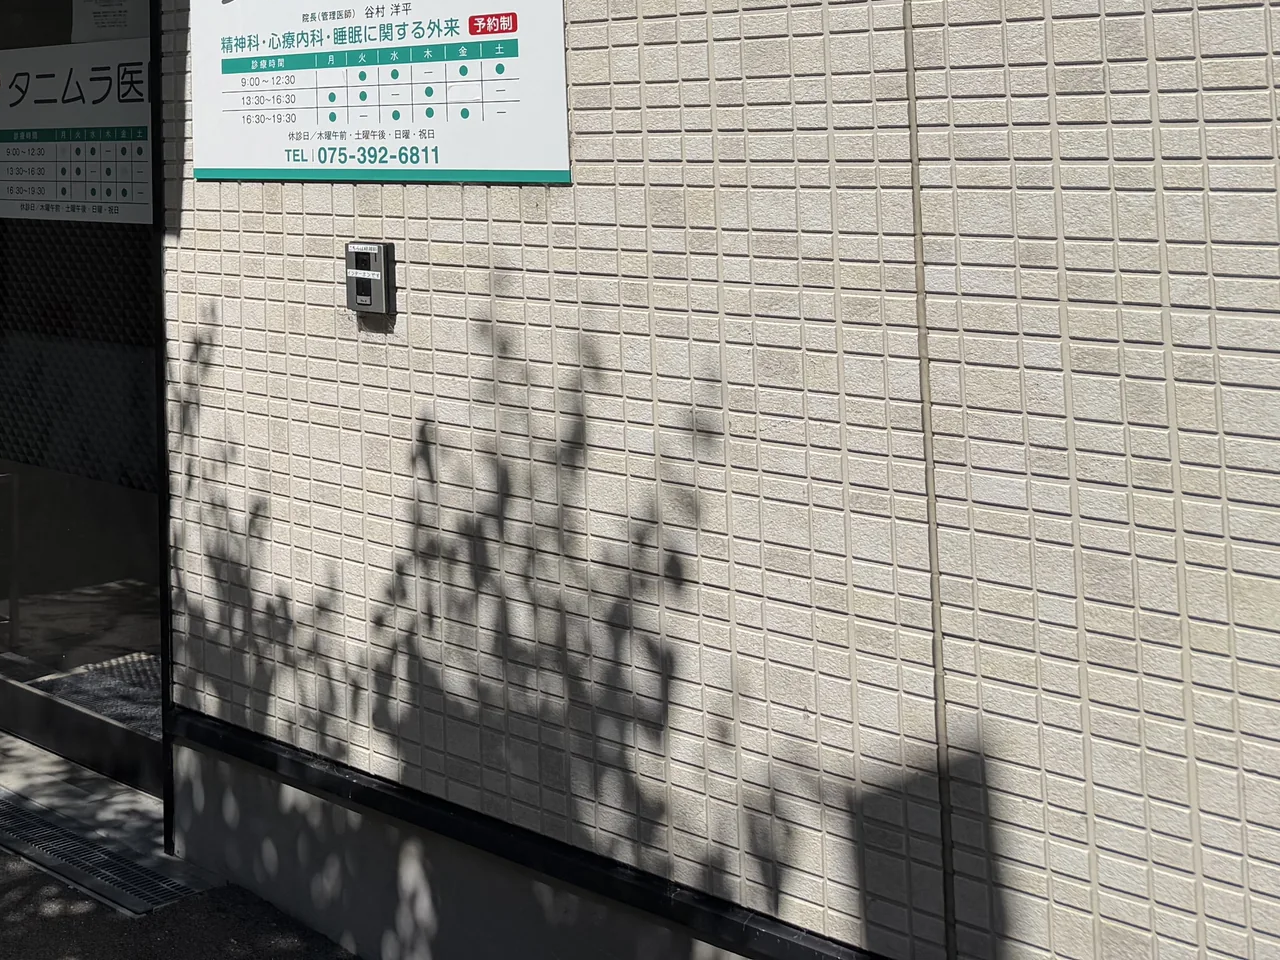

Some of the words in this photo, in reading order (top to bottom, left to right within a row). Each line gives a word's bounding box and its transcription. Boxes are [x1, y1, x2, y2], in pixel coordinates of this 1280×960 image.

[364, 5, 386, 18] 谷村
[390, 2, 412, 16] 洋平
[220, 17, 461, 53] 精神科・心療内科・睡眠に関する外来
[473, 15, 513, 33] 予約制
[251, 59, 286, 70] 診療時間
[327, 54, 335, 66] 月
[358, 53, 367, 64] 火
[390, 50, 399, 62] 水
[423, 48, 433, 59] 木
[458, 45, 469, 57] 金
[495, 44, 505, 54] 土
[9, 61, 152, 108] タニムラ医
[284, 148, 308, 163] TEL
[317, 145, 439, 165] 075-392-6811
